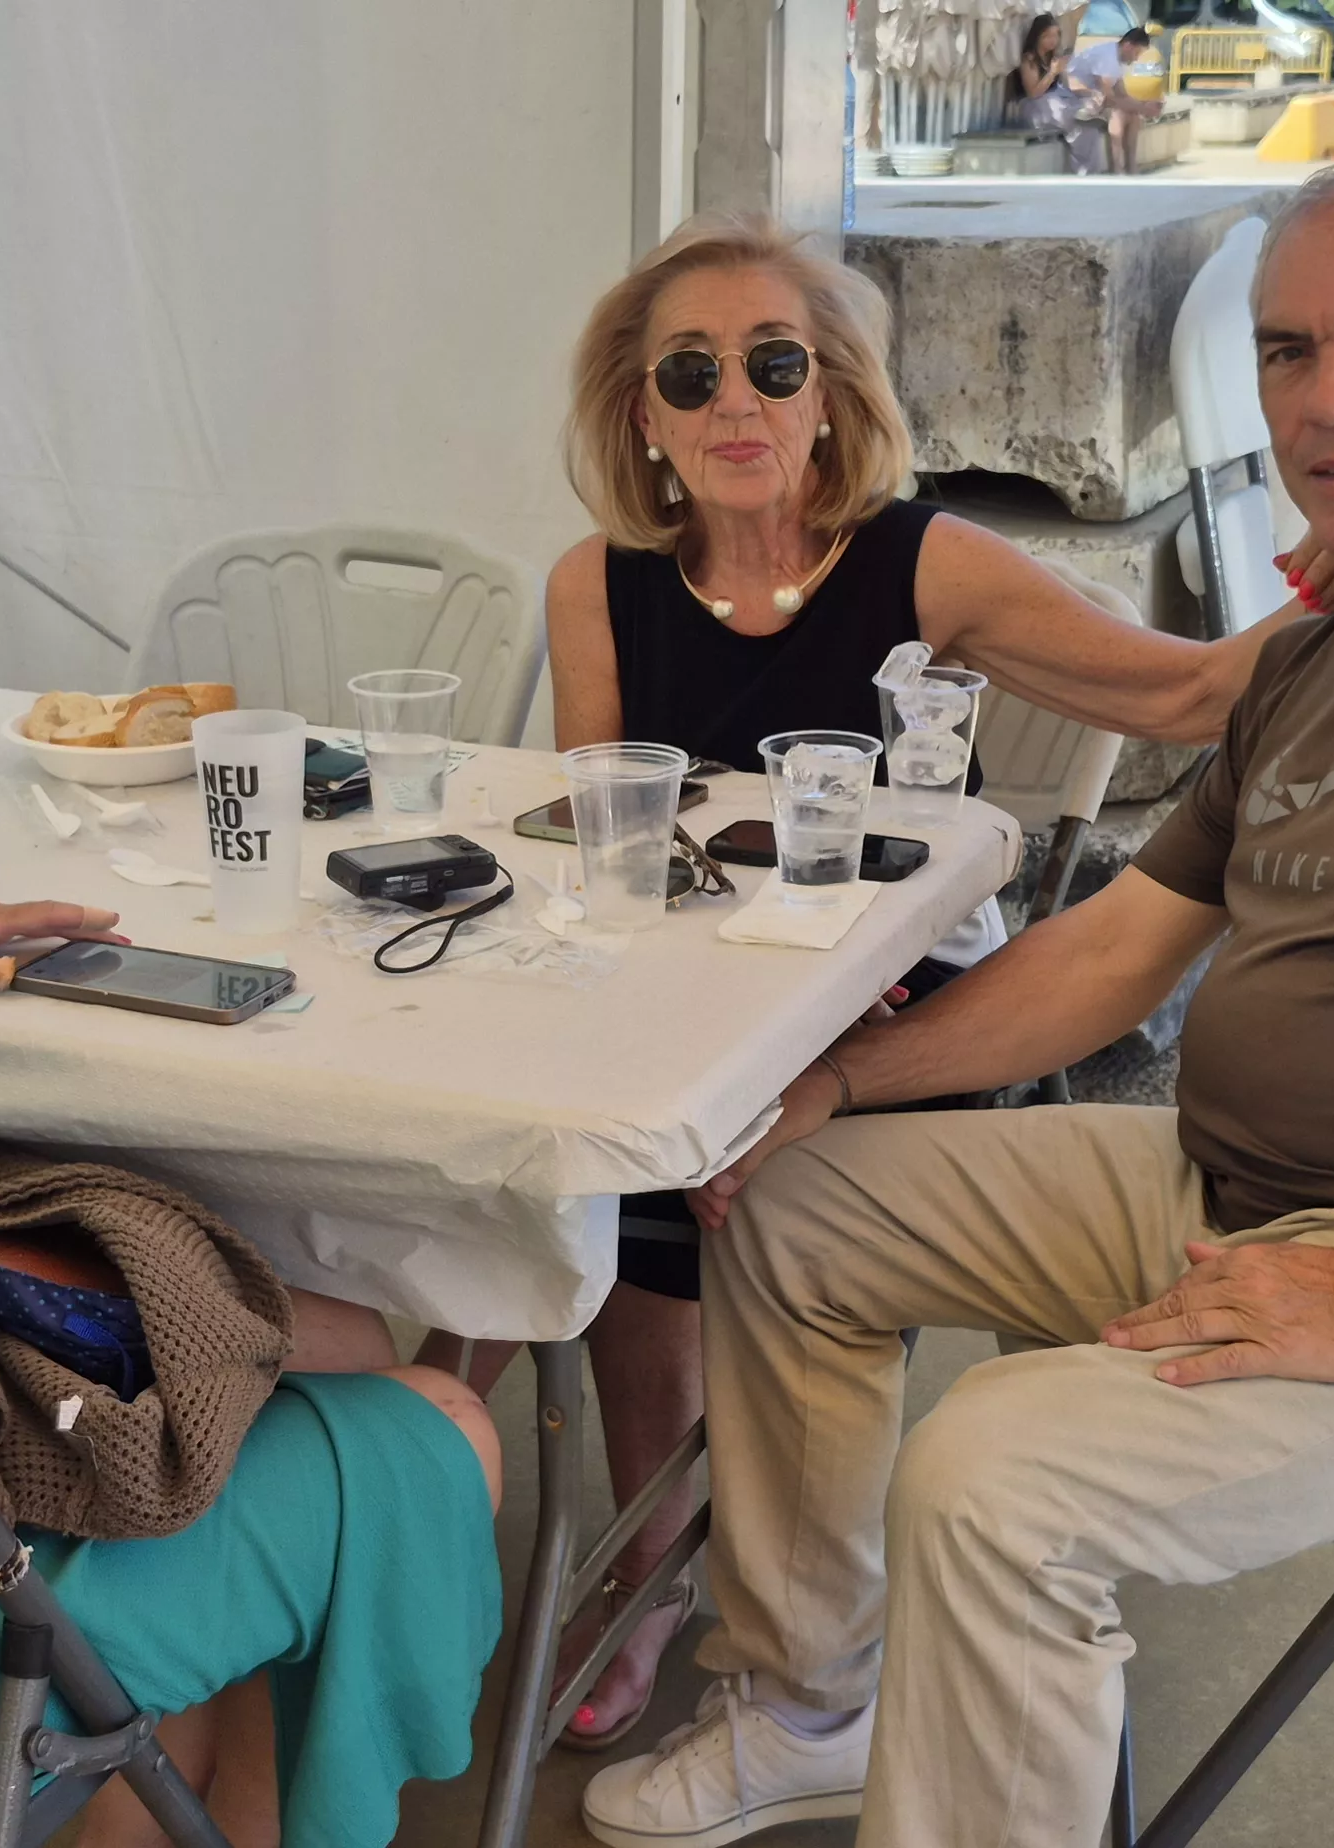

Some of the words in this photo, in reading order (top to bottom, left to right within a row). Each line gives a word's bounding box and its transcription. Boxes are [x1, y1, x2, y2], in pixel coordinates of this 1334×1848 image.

[202, 761, 259, 798] NEU
[206, 794, 243, 829] RO
[210, 826, 272, 862] FEST
[1252, 850, 1330, 892] NIKE
